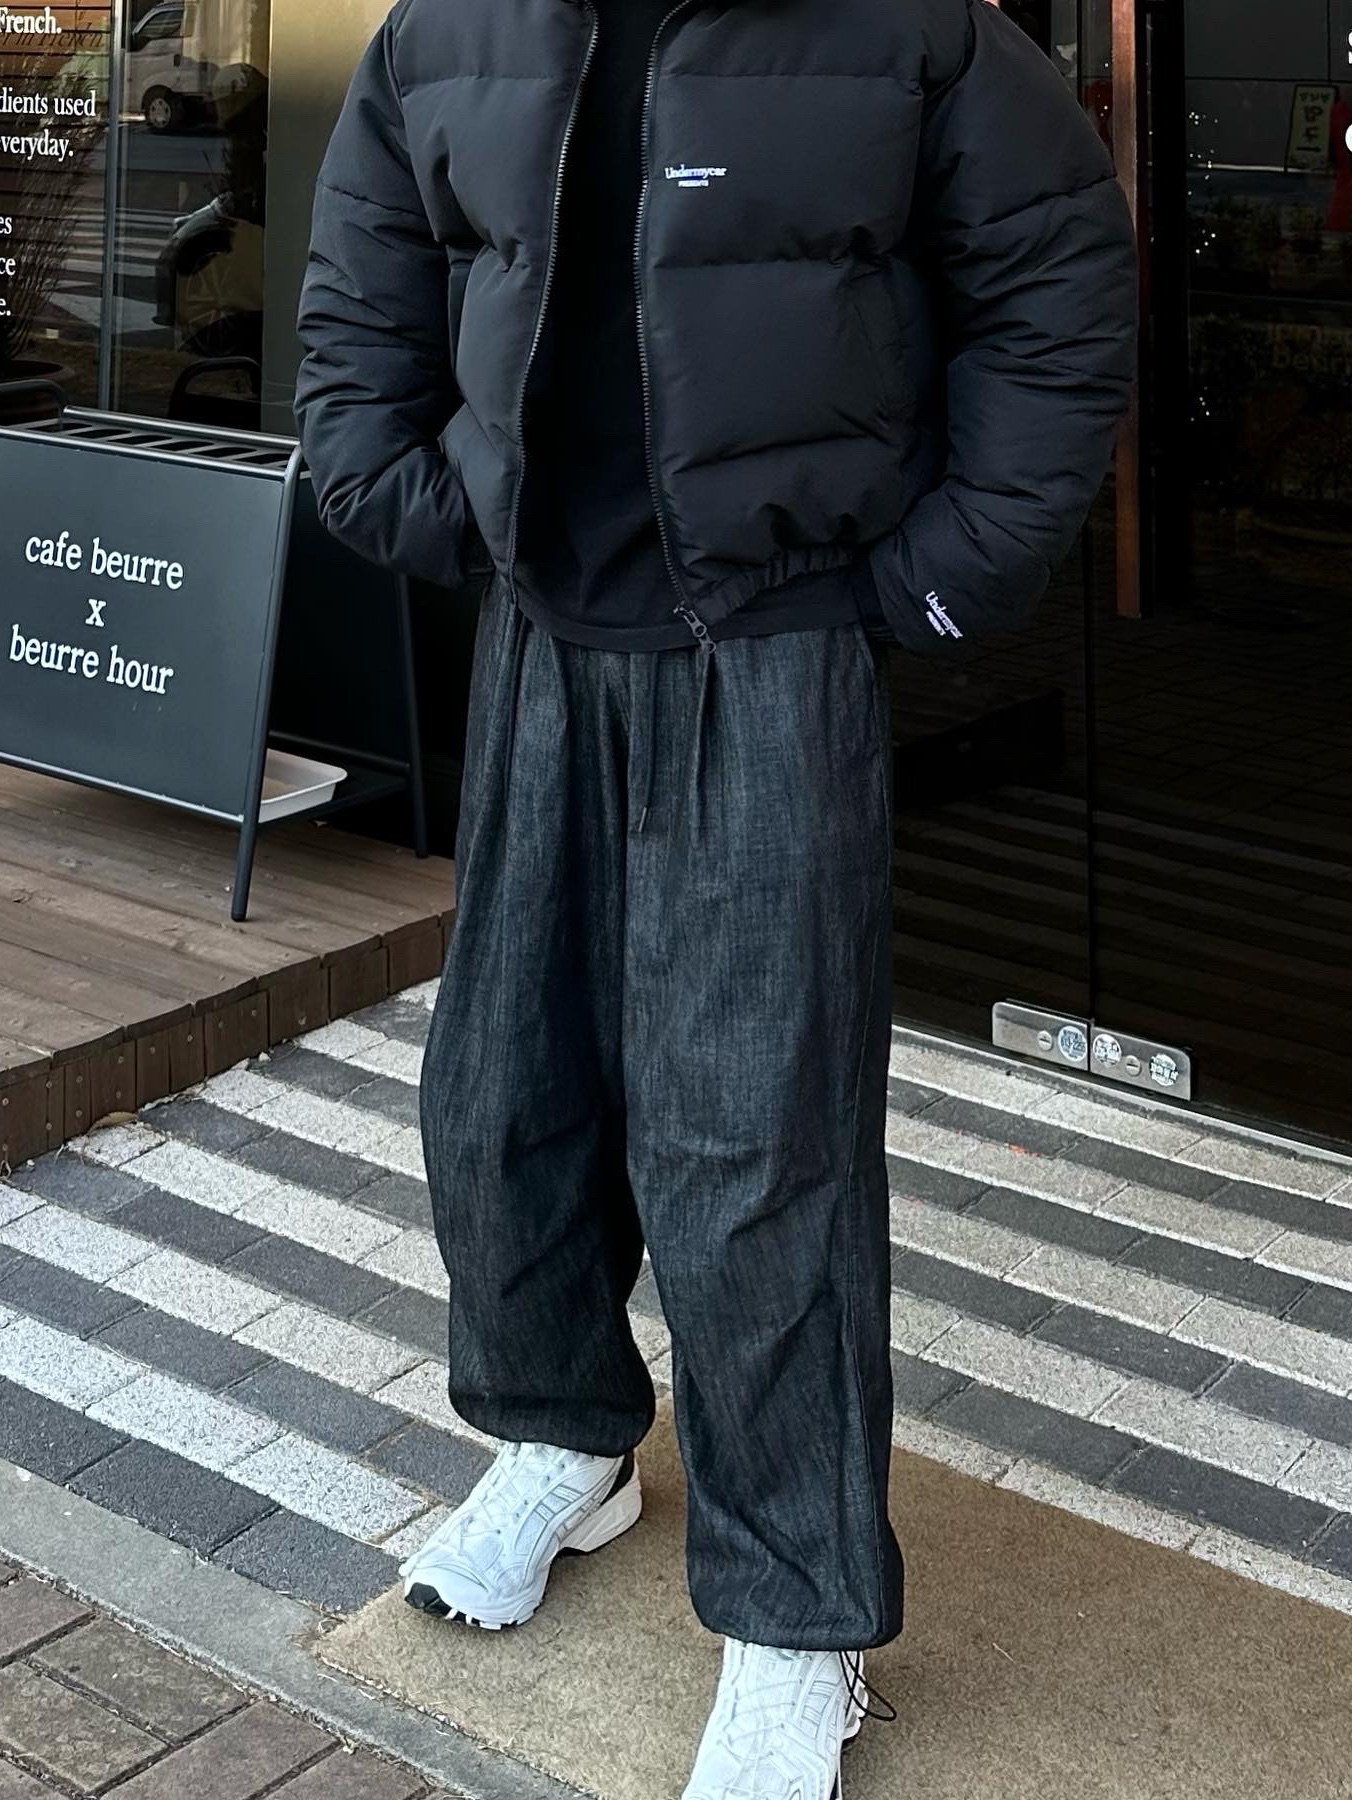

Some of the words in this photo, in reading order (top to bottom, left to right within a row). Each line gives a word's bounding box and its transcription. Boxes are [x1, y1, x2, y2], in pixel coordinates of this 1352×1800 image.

[54, 89, 96, 117] used
[25, 531, 82, 570] cafe
[90, 537, 184, 590] beurre
[85, 598, 107, 627] x
[9, 624, 100, 678] beurre
[106, 644, 174, 694] hour
